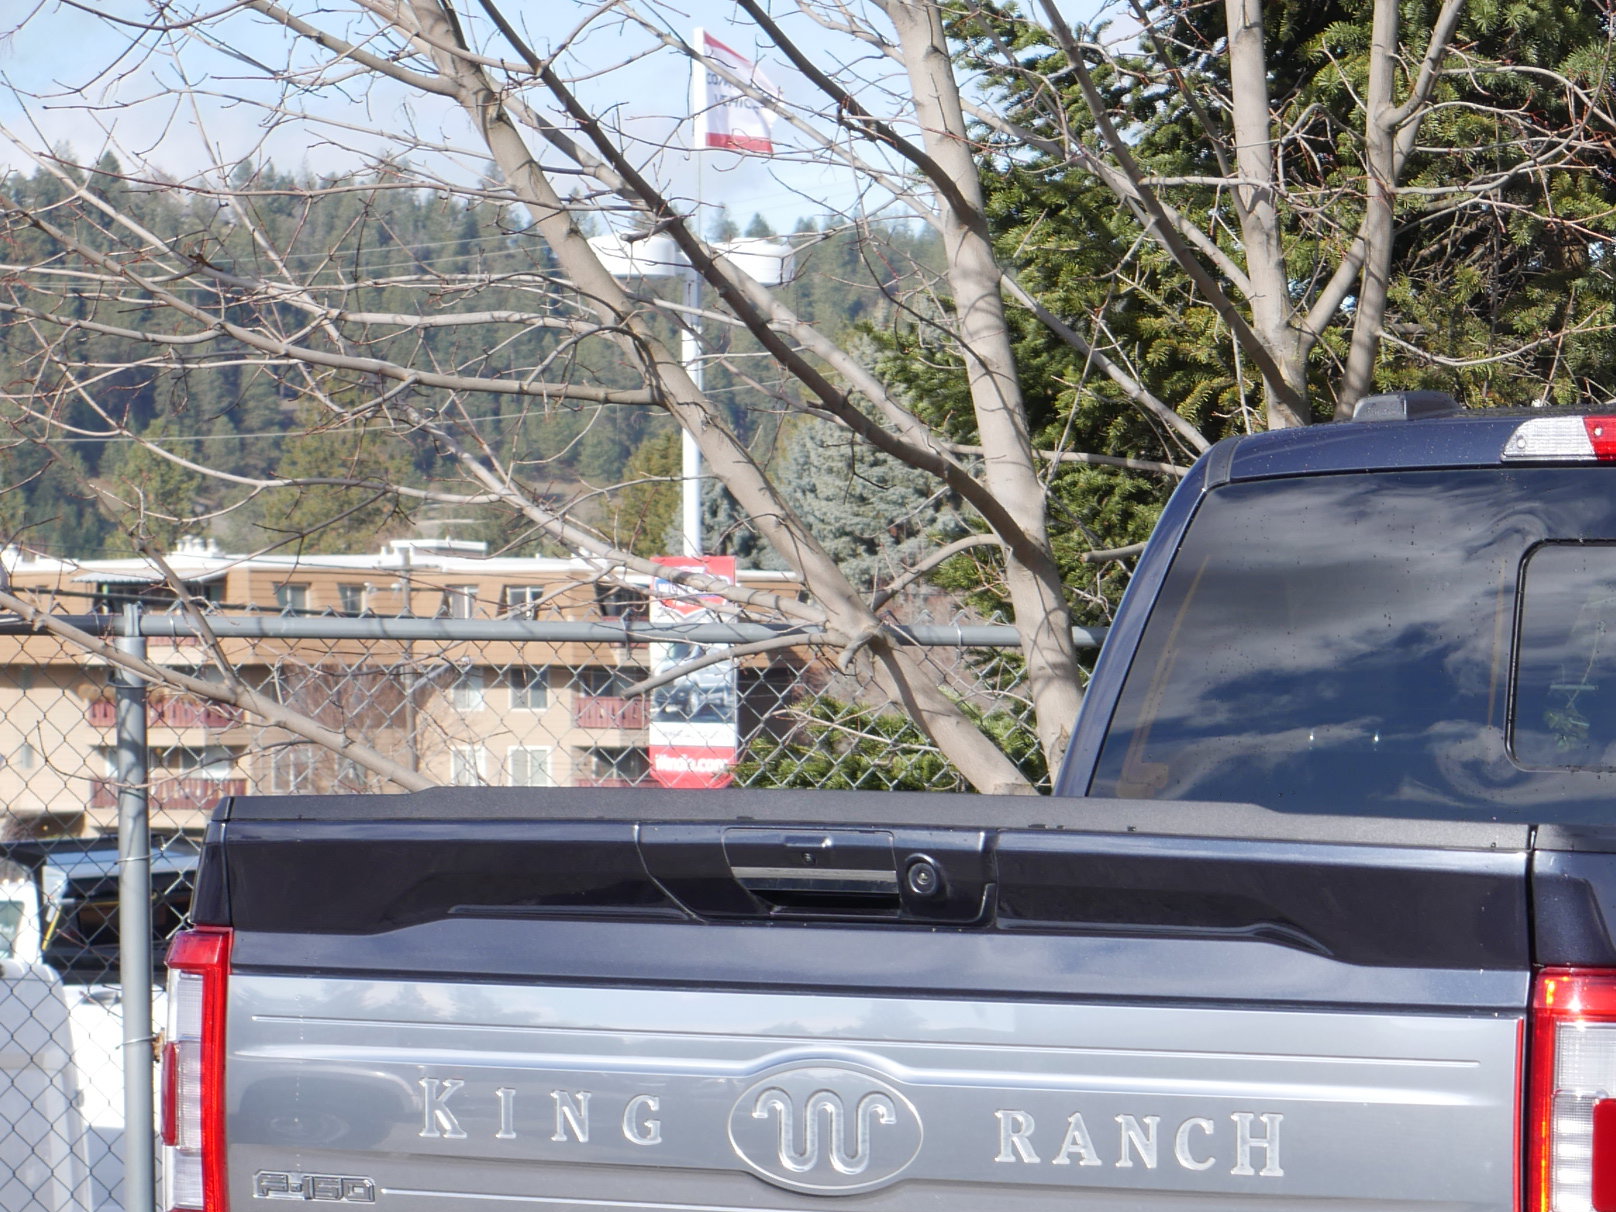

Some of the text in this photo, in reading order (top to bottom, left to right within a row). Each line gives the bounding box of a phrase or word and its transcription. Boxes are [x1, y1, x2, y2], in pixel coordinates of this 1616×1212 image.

[419, 1077, 1285, 1177] KING RANCH
[253, 1169, 375, 1204] F-150
